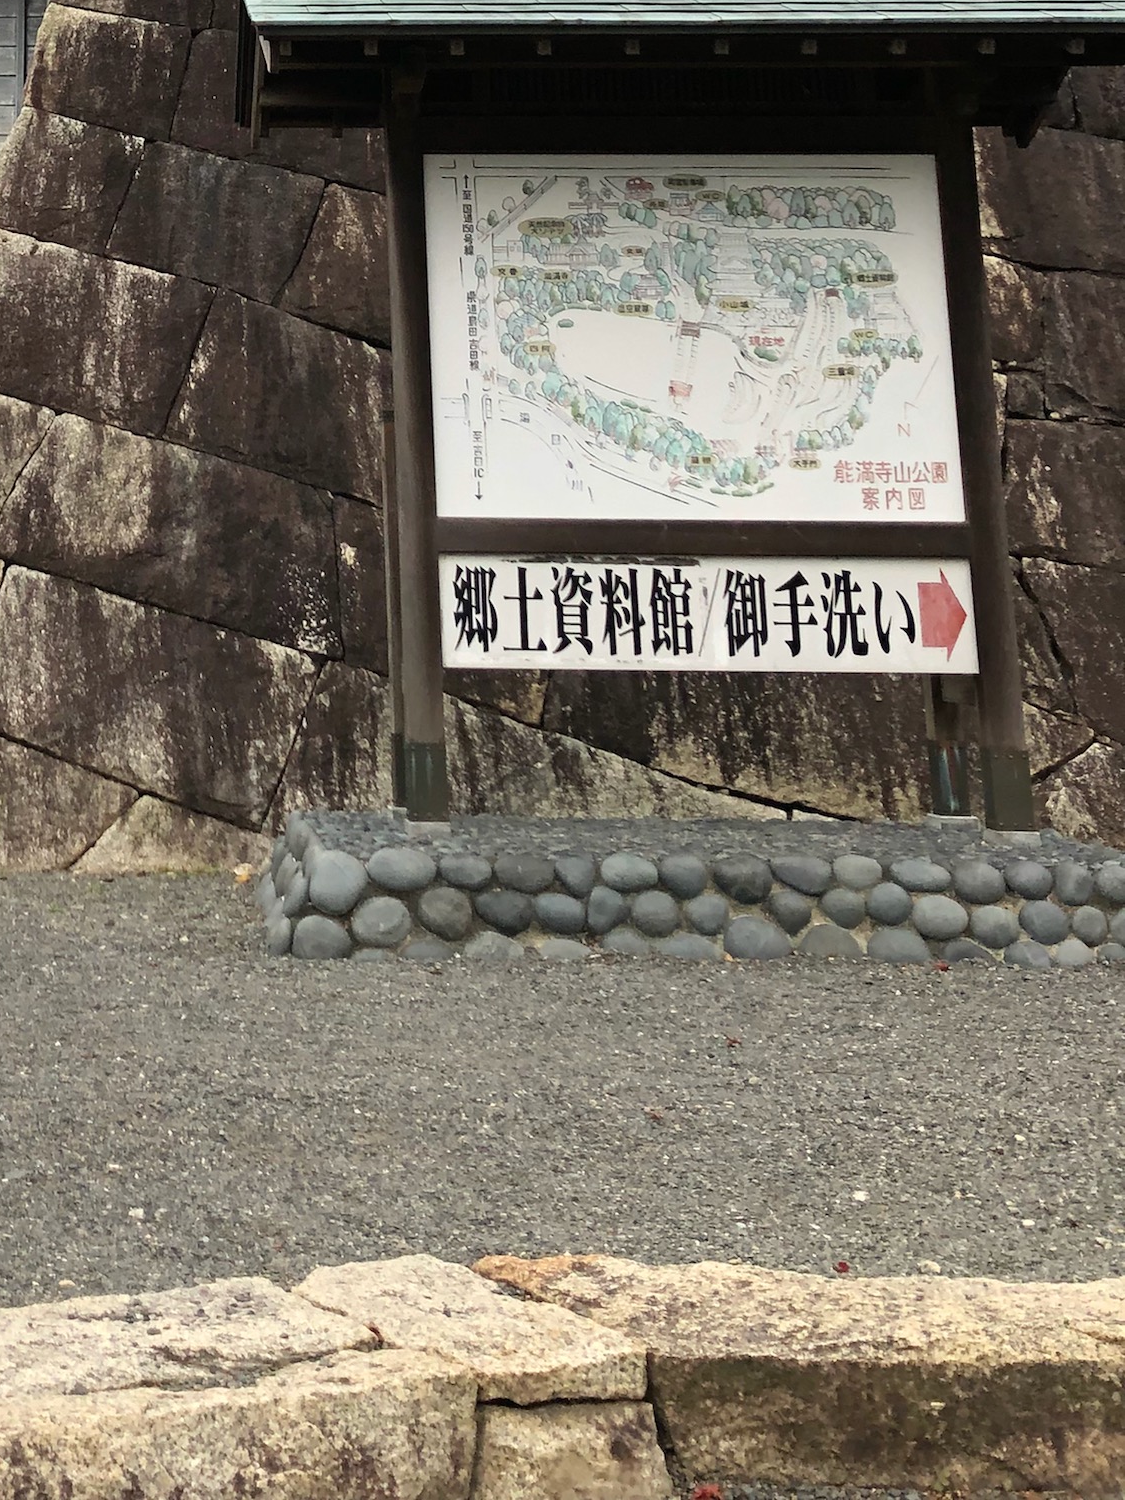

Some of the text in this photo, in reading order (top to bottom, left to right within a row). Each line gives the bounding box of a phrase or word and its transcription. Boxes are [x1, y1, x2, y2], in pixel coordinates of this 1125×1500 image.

[701, 192, 720, 200] WC
[719, 300, 750, 309] 小山城
[853, 330, 873, 339] WC
[748, 335, 785, 347] 現在地
[897, 423, 911, 437] N
[793, 459, 818, 469] 大手門
[833, 459, 949, 484] 能満寺山公園
[861, 487, 926, 511] 案内図
